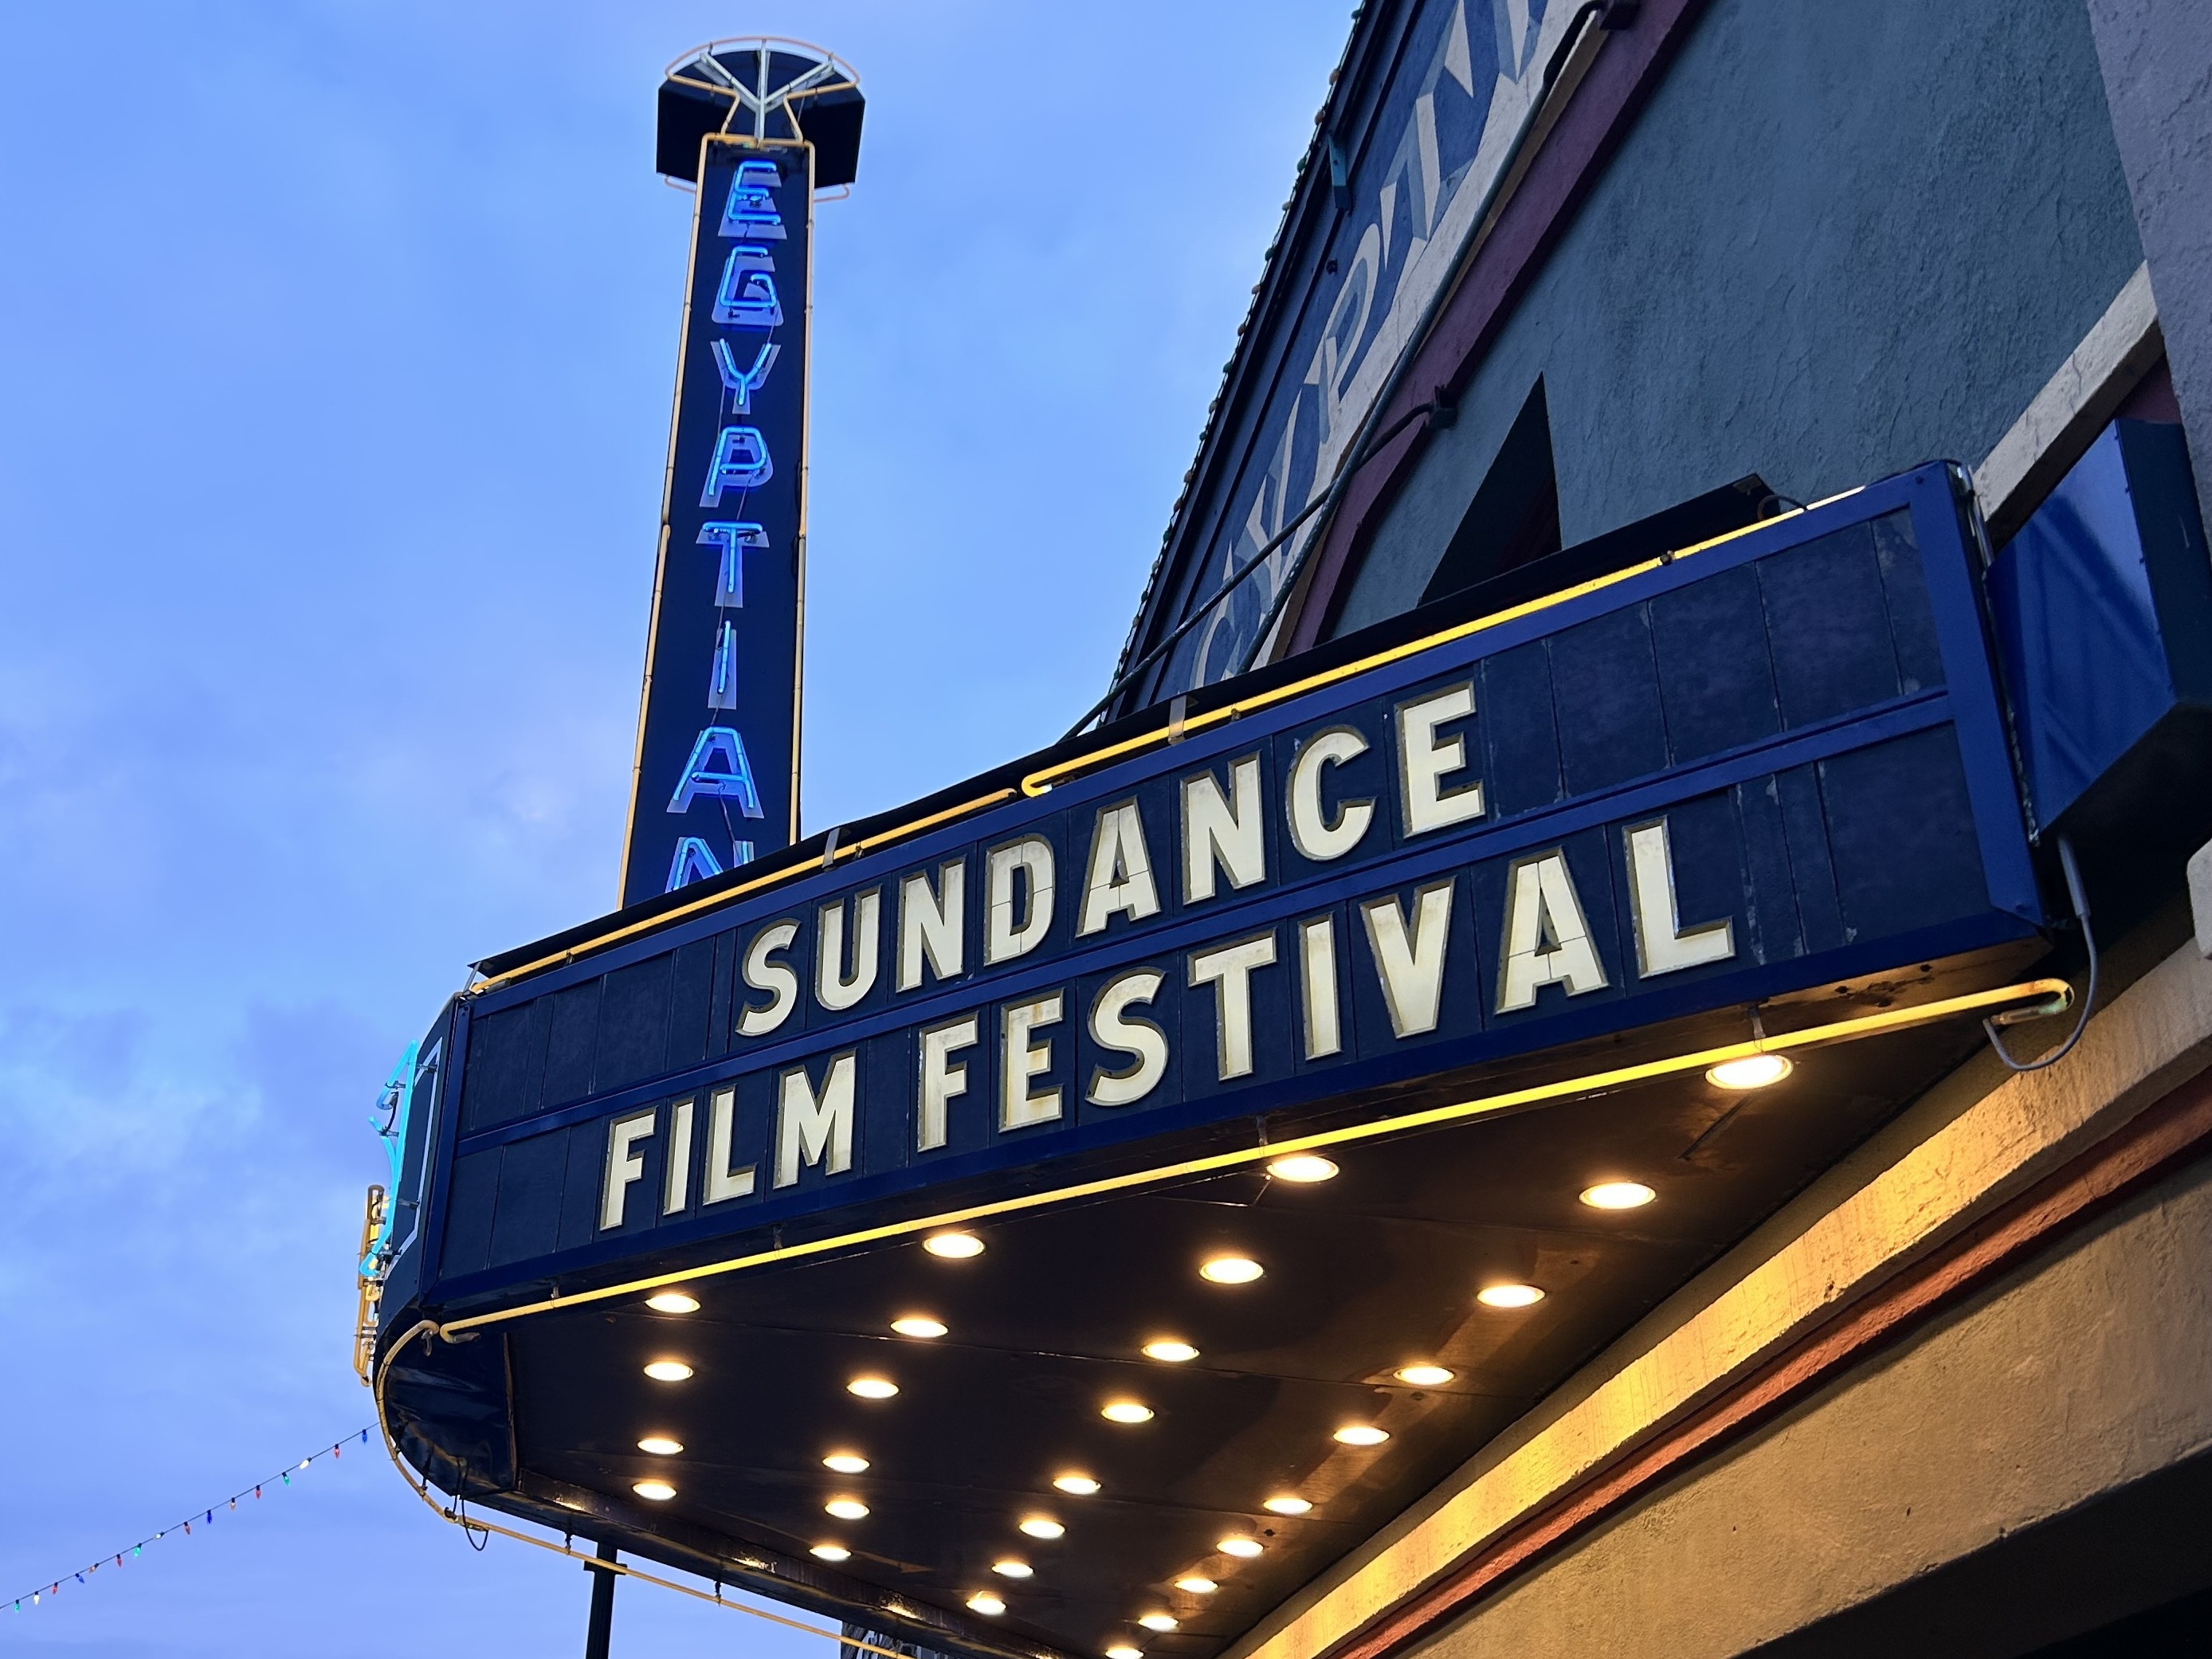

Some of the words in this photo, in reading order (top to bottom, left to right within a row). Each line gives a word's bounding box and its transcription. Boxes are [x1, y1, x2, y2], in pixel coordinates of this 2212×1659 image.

[599, 1047, 858, 1231] FILM
[917, 814, 1736, 1153] FESTIVAL
[735, 680, 1487, 1037] SUNDANCE
